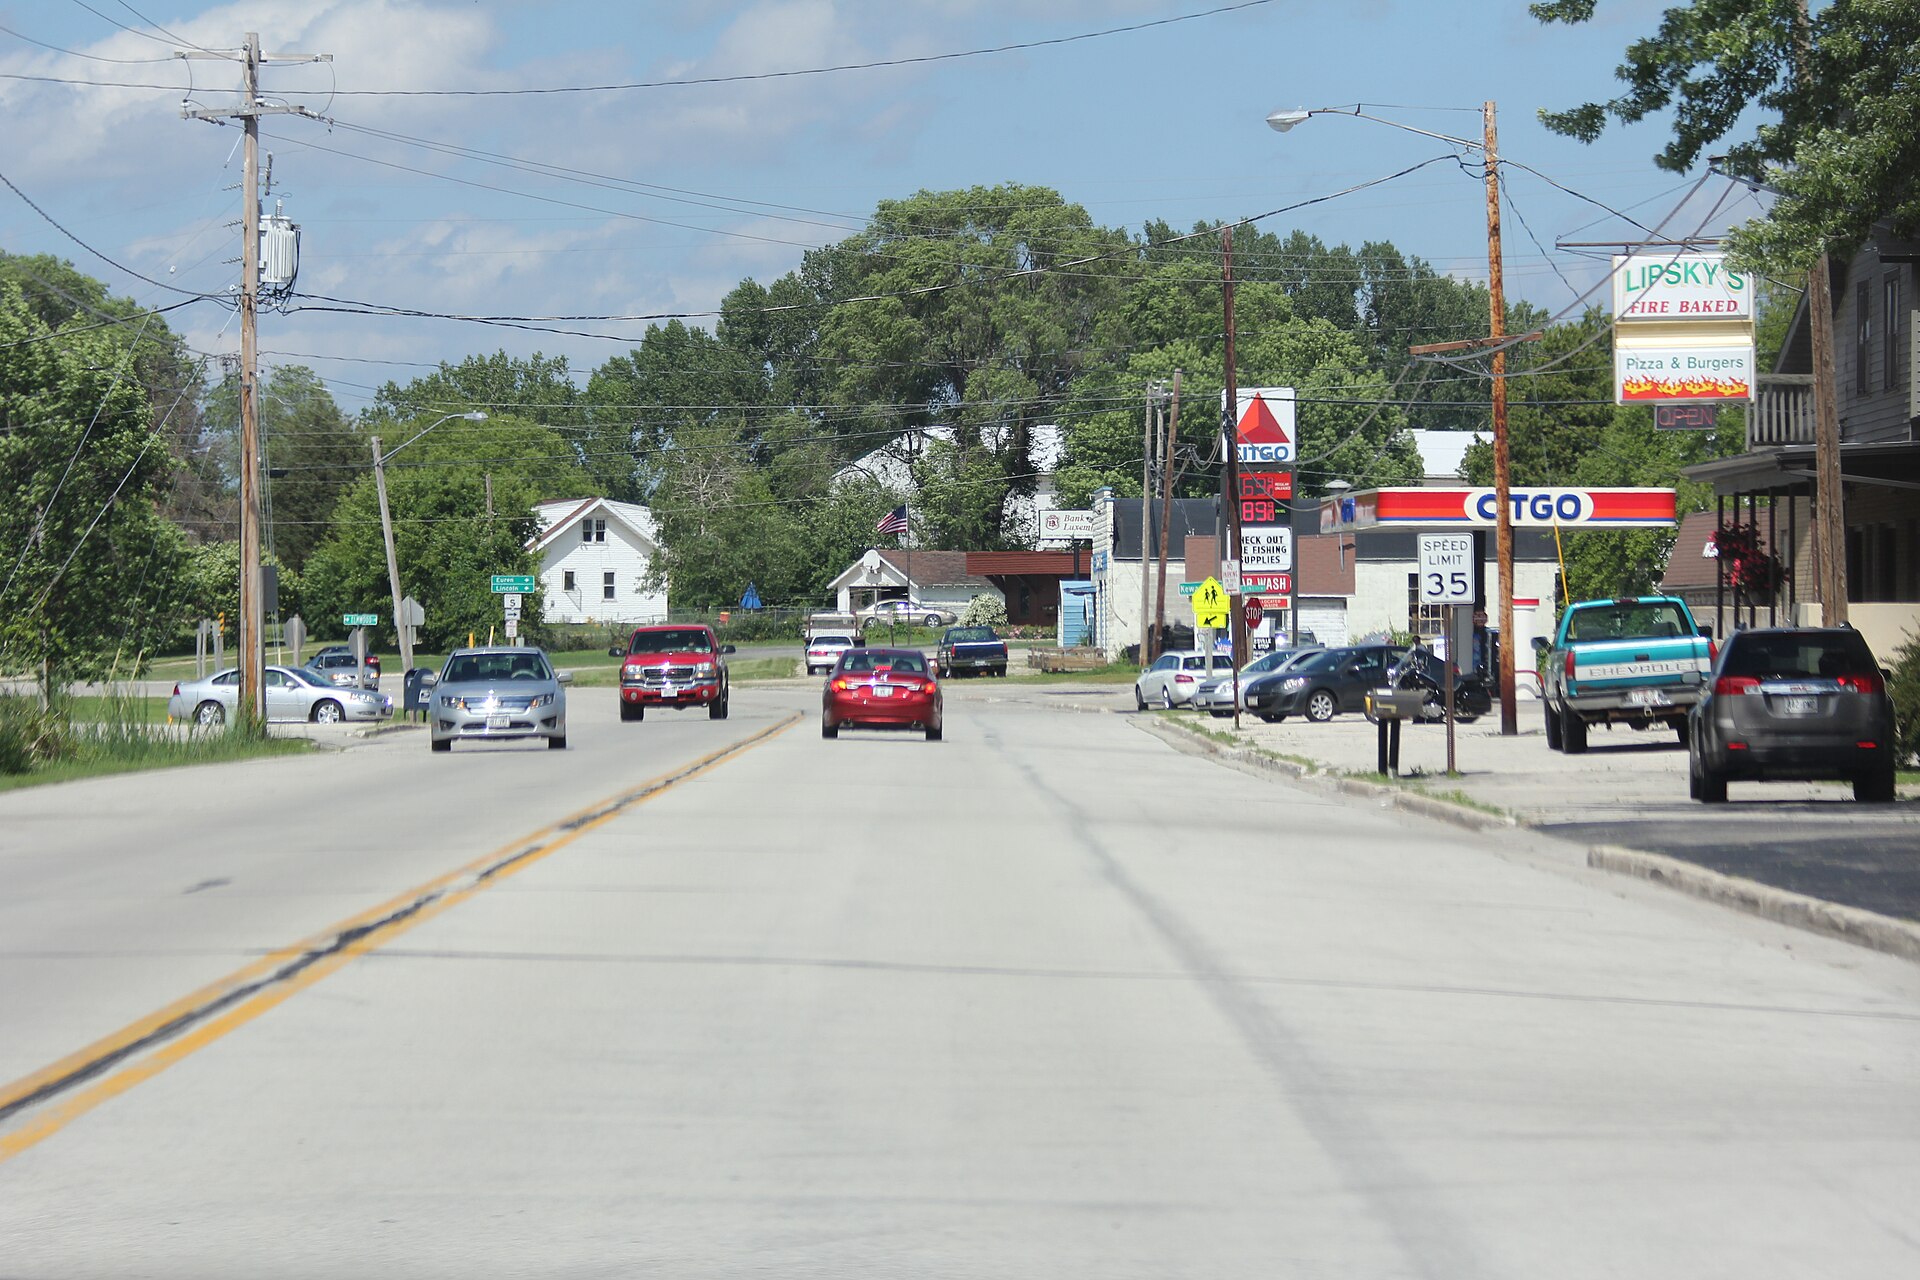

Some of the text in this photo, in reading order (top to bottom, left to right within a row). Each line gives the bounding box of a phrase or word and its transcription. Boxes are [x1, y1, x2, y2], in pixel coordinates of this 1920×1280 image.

[1626, 262, 1744, 292] LIPSKY'S
[1631, 300, 1738, 314] FIRE BAKED
[1626, 356, 1744, 371] Pizza & Burgers
[1658, 408, 1713, 426] OPEN
[1477, 493, 1581, 520] CTGO
[1241, 536, 1283, 544] HECK OUT
[1424, 540, 1468, 551] SPEED
[1252, 546, 1287, 554] FISHING
[1429, 555, 1463, 565] LIMIT
[1257, 577, 1286, 590] WASH
[1427, 573, 1468, 595] 35
[1246, 607, 1261, 619] STOP
[1590, 663, 1696, 677] CHEVROLET
